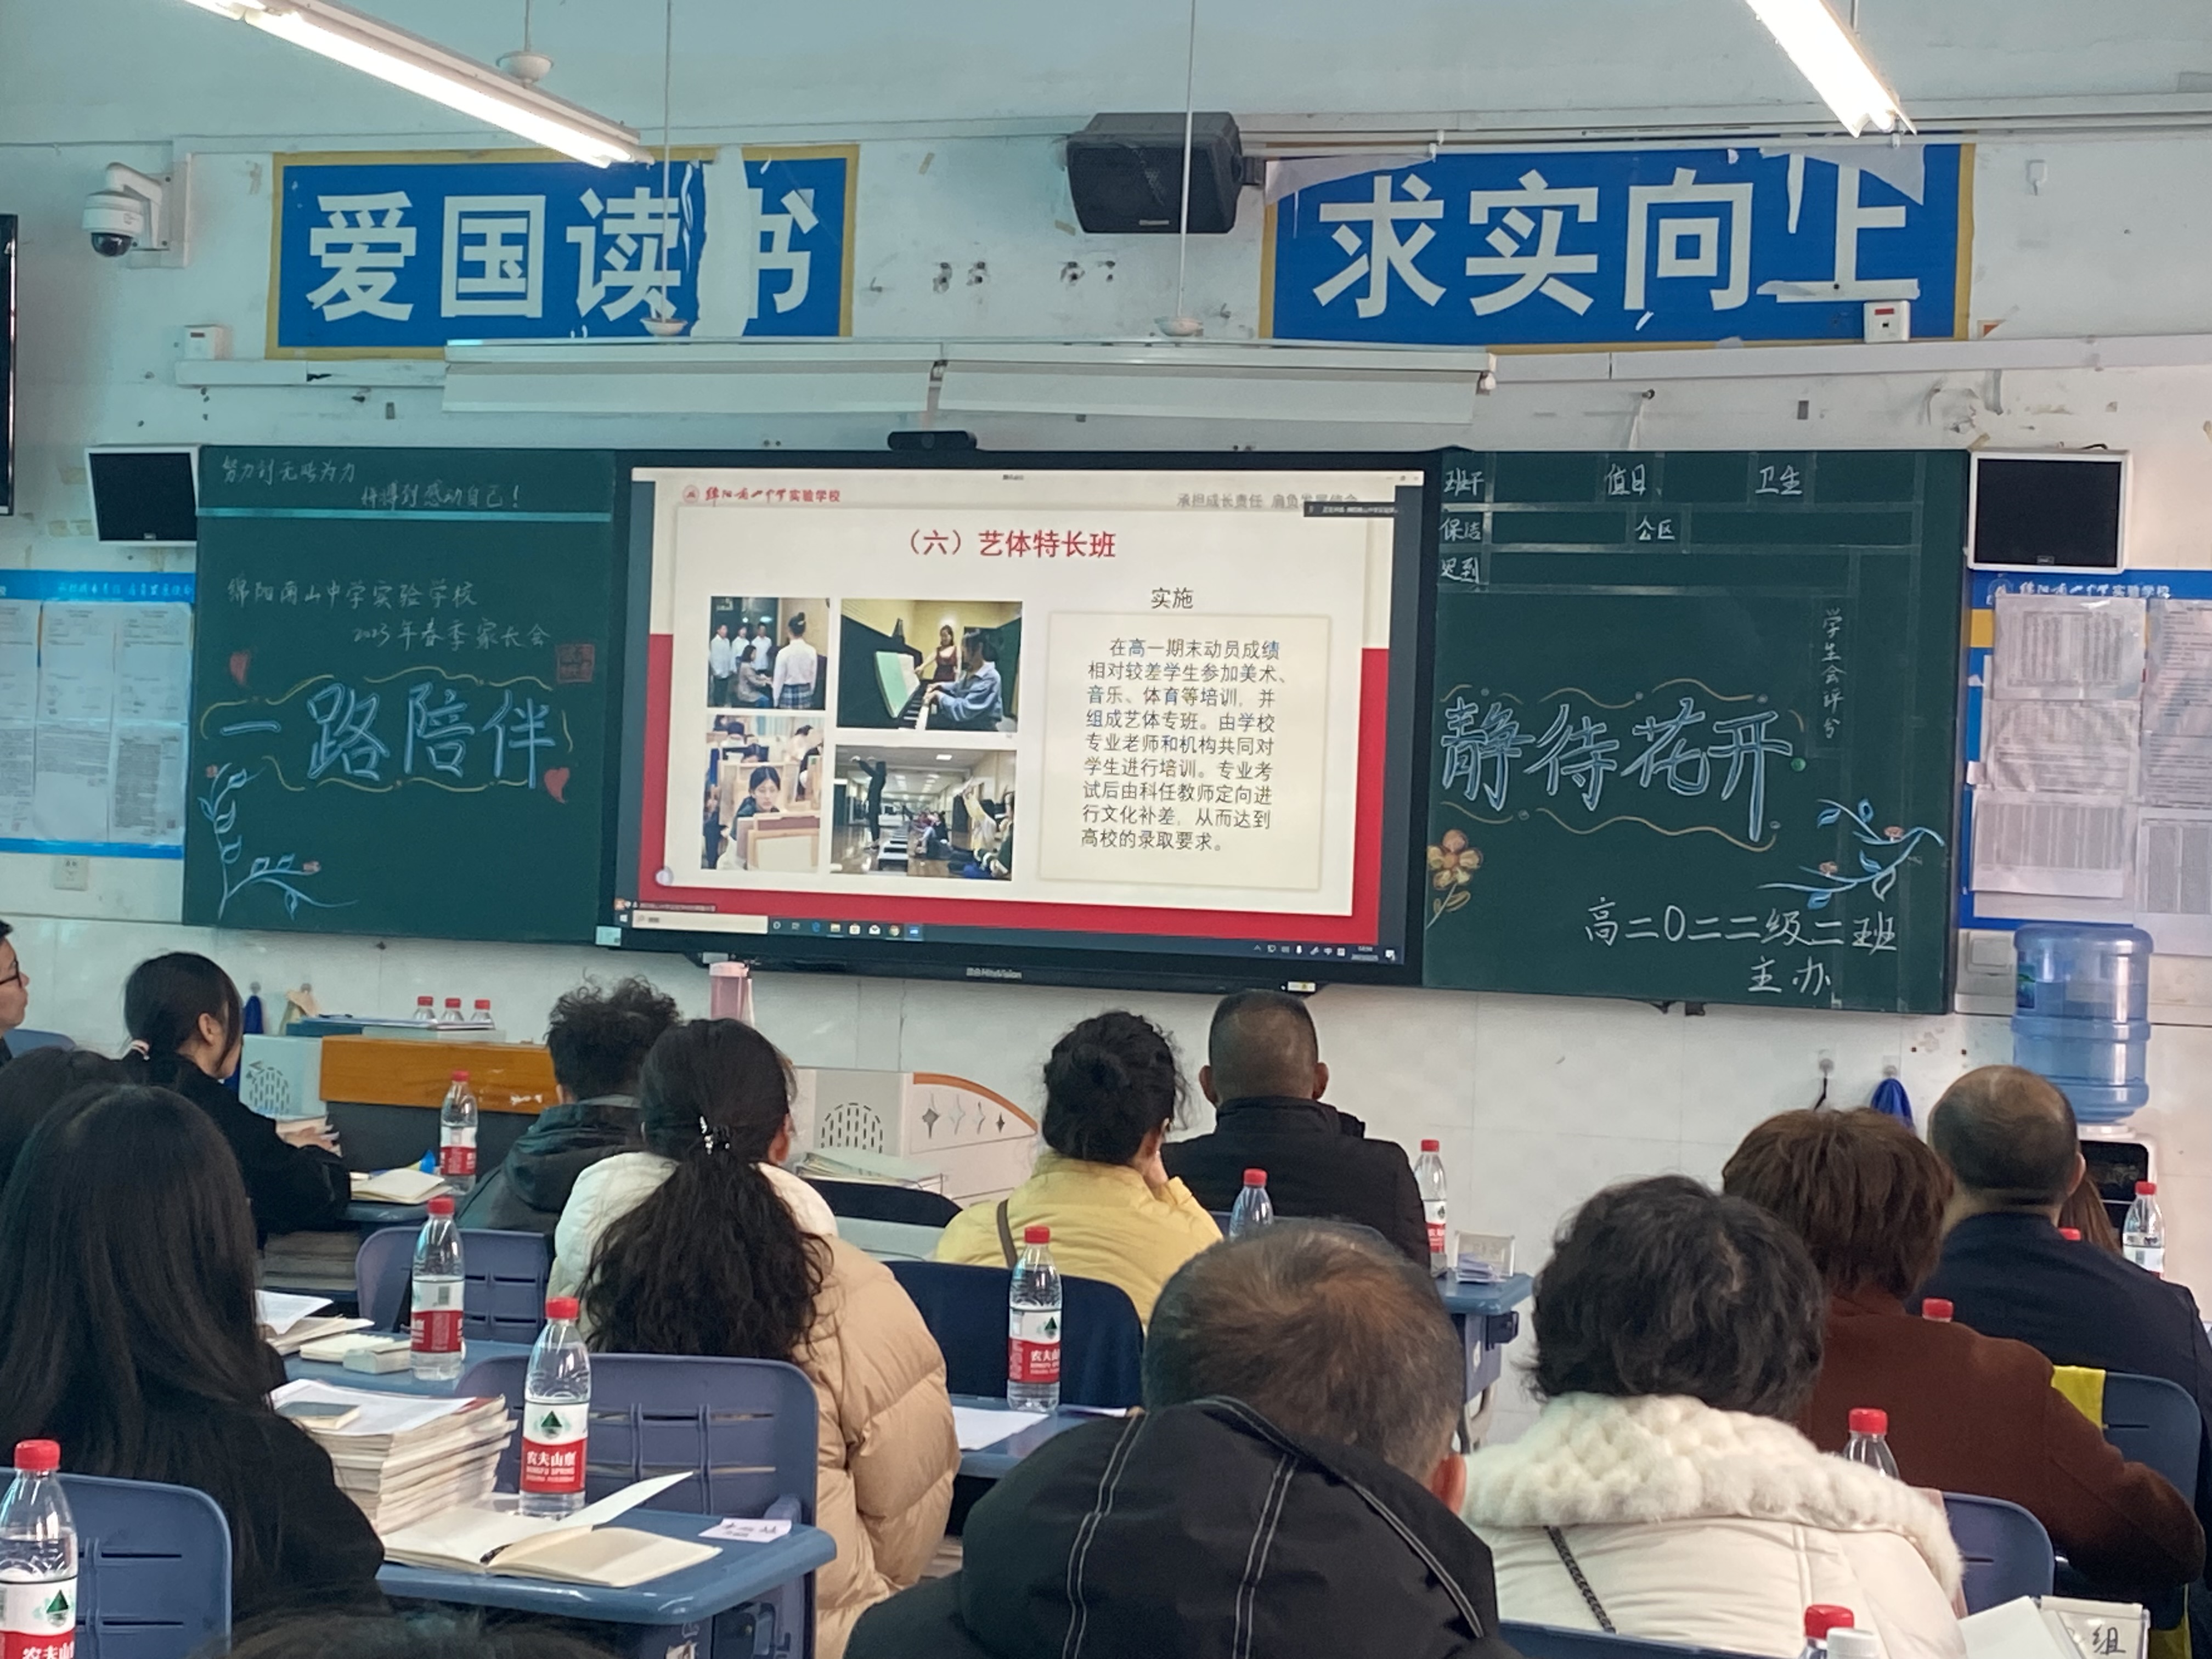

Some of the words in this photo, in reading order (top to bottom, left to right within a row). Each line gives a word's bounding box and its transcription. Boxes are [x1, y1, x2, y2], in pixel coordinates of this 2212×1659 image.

[306, 187, 819, 321] 爱国读书
[1312, 166, 1920, 319] 求实向上
[1443, 469, 1484, 496] 班干
[1604, 462, 1646, 495] 值日
[1756, 464, 1803, 495] 卫生
[1177, 493, 1263, 509] 承担成长责任
[1439, 516, 1482, 541] 保洁
[1635, 516, 1675, 541] 公区
[909, 529, 1116, 559] （六）艺体特长班
[1440, 557, 1481, 584] 迟到
[227, 575, 478, 610] 绵阳南山中学实验学校
[1151, 587, 1194, 609] 实施
[1109, 638, 1279, 660] 在高一期末动员成绩
[1088, 661, 1286, 684] 相对较差学生参加美术、
[1086, 710, 1276, 732] 组成艺体专班。由学校
[222, 682, 555, 789] 一路陪伴
[1085, 733, 1274, 756] 专业老师和机构共同对
[1084, 758, 1273, 782] 学生进行培训。专业考
[1441, 696, 1793, 842] 静待花开
[1083, 781, 1272, 805] 试后由科任教师定向进
[1081, 828, 1222, 851] 高校的录取要求。
[1748, 955, 1832, 996] 主办
[2092, 1624, 2126, 1655] 组
